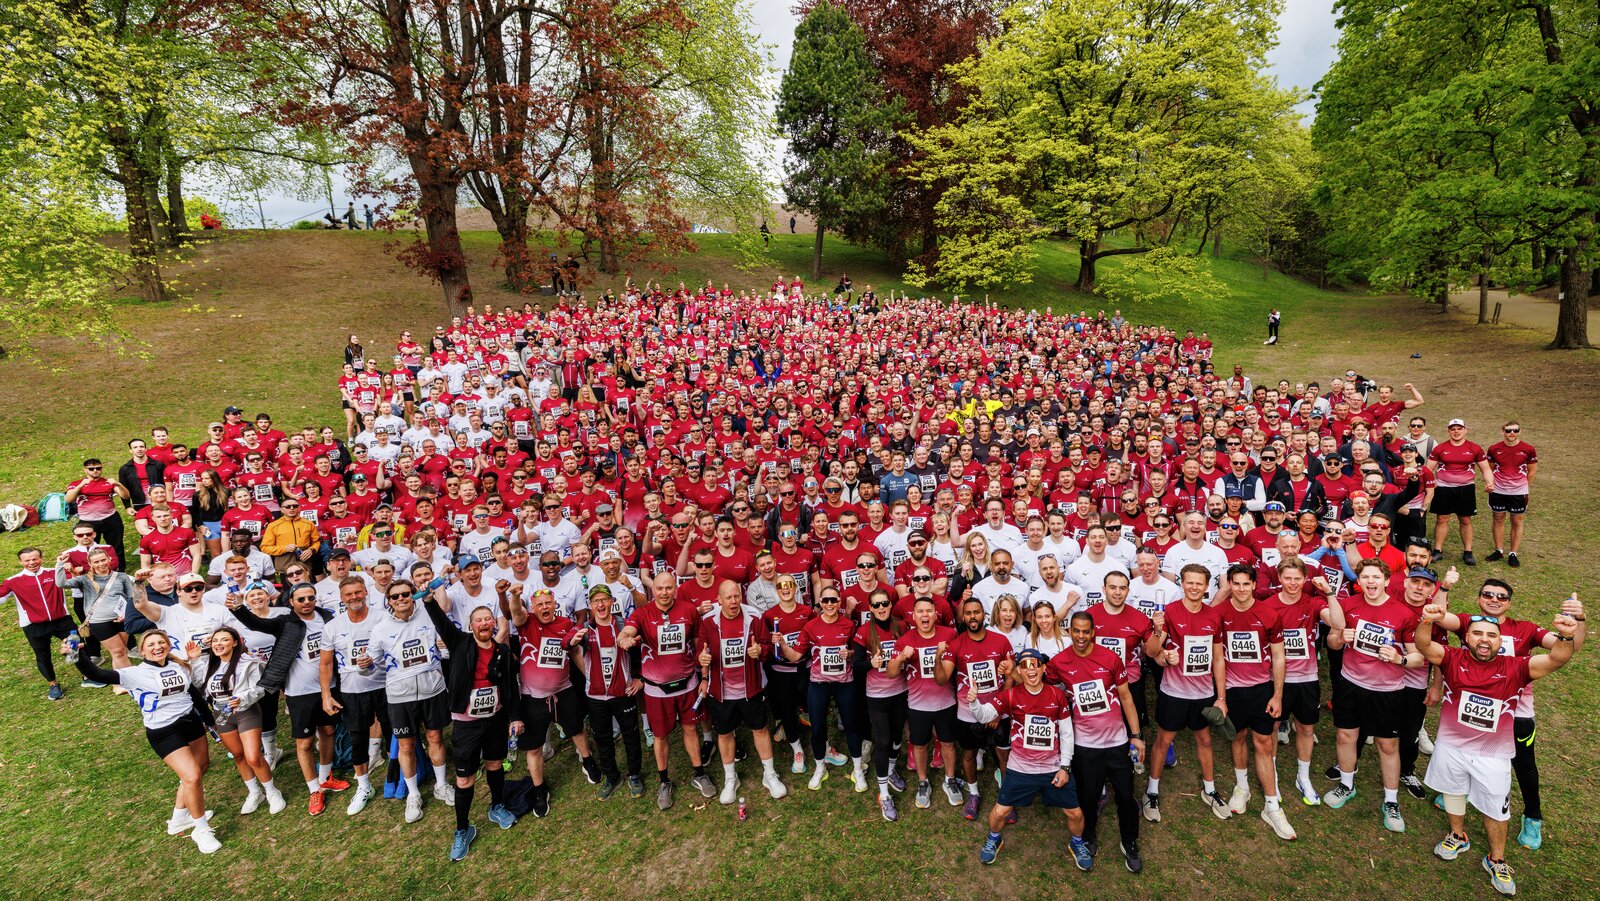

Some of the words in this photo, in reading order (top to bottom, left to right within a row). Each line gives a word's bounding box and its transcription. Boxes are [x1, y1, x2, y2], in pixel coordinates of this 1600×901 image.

[1328, 576, 1339, 585] 54
[611, 603, 620, 612] 70
[1060, 619, 1068, 628] 47
[1366, 624, 1382, 633] trumf
[661, 632, 682, 643] 6446
[1359, 630, 1384, 645] 6446
[1232, 640, 1256, 650] 6446
[402, 645, 425, 659] 6470
[543, 646, 563, 656] 6438
[725, 646, 745, 656] 6445
[823, 655, 843, 663] 6408
[923, 656, 934, 665] 64
[1188, 654, 1209, 664] 6408
[602, 664, 614, 673] 51
[972, 670, 993, 681] 6446
[161, 675, 184, 687] 6470
[1078, 690, 1103, 703] 6434
[1472, 696, 1491, 705] trumf
[474, 696, 495, 708] 6449
[1464, 703, 1495, 718] 6424
[1028, 725, 1051, 736] 6426
